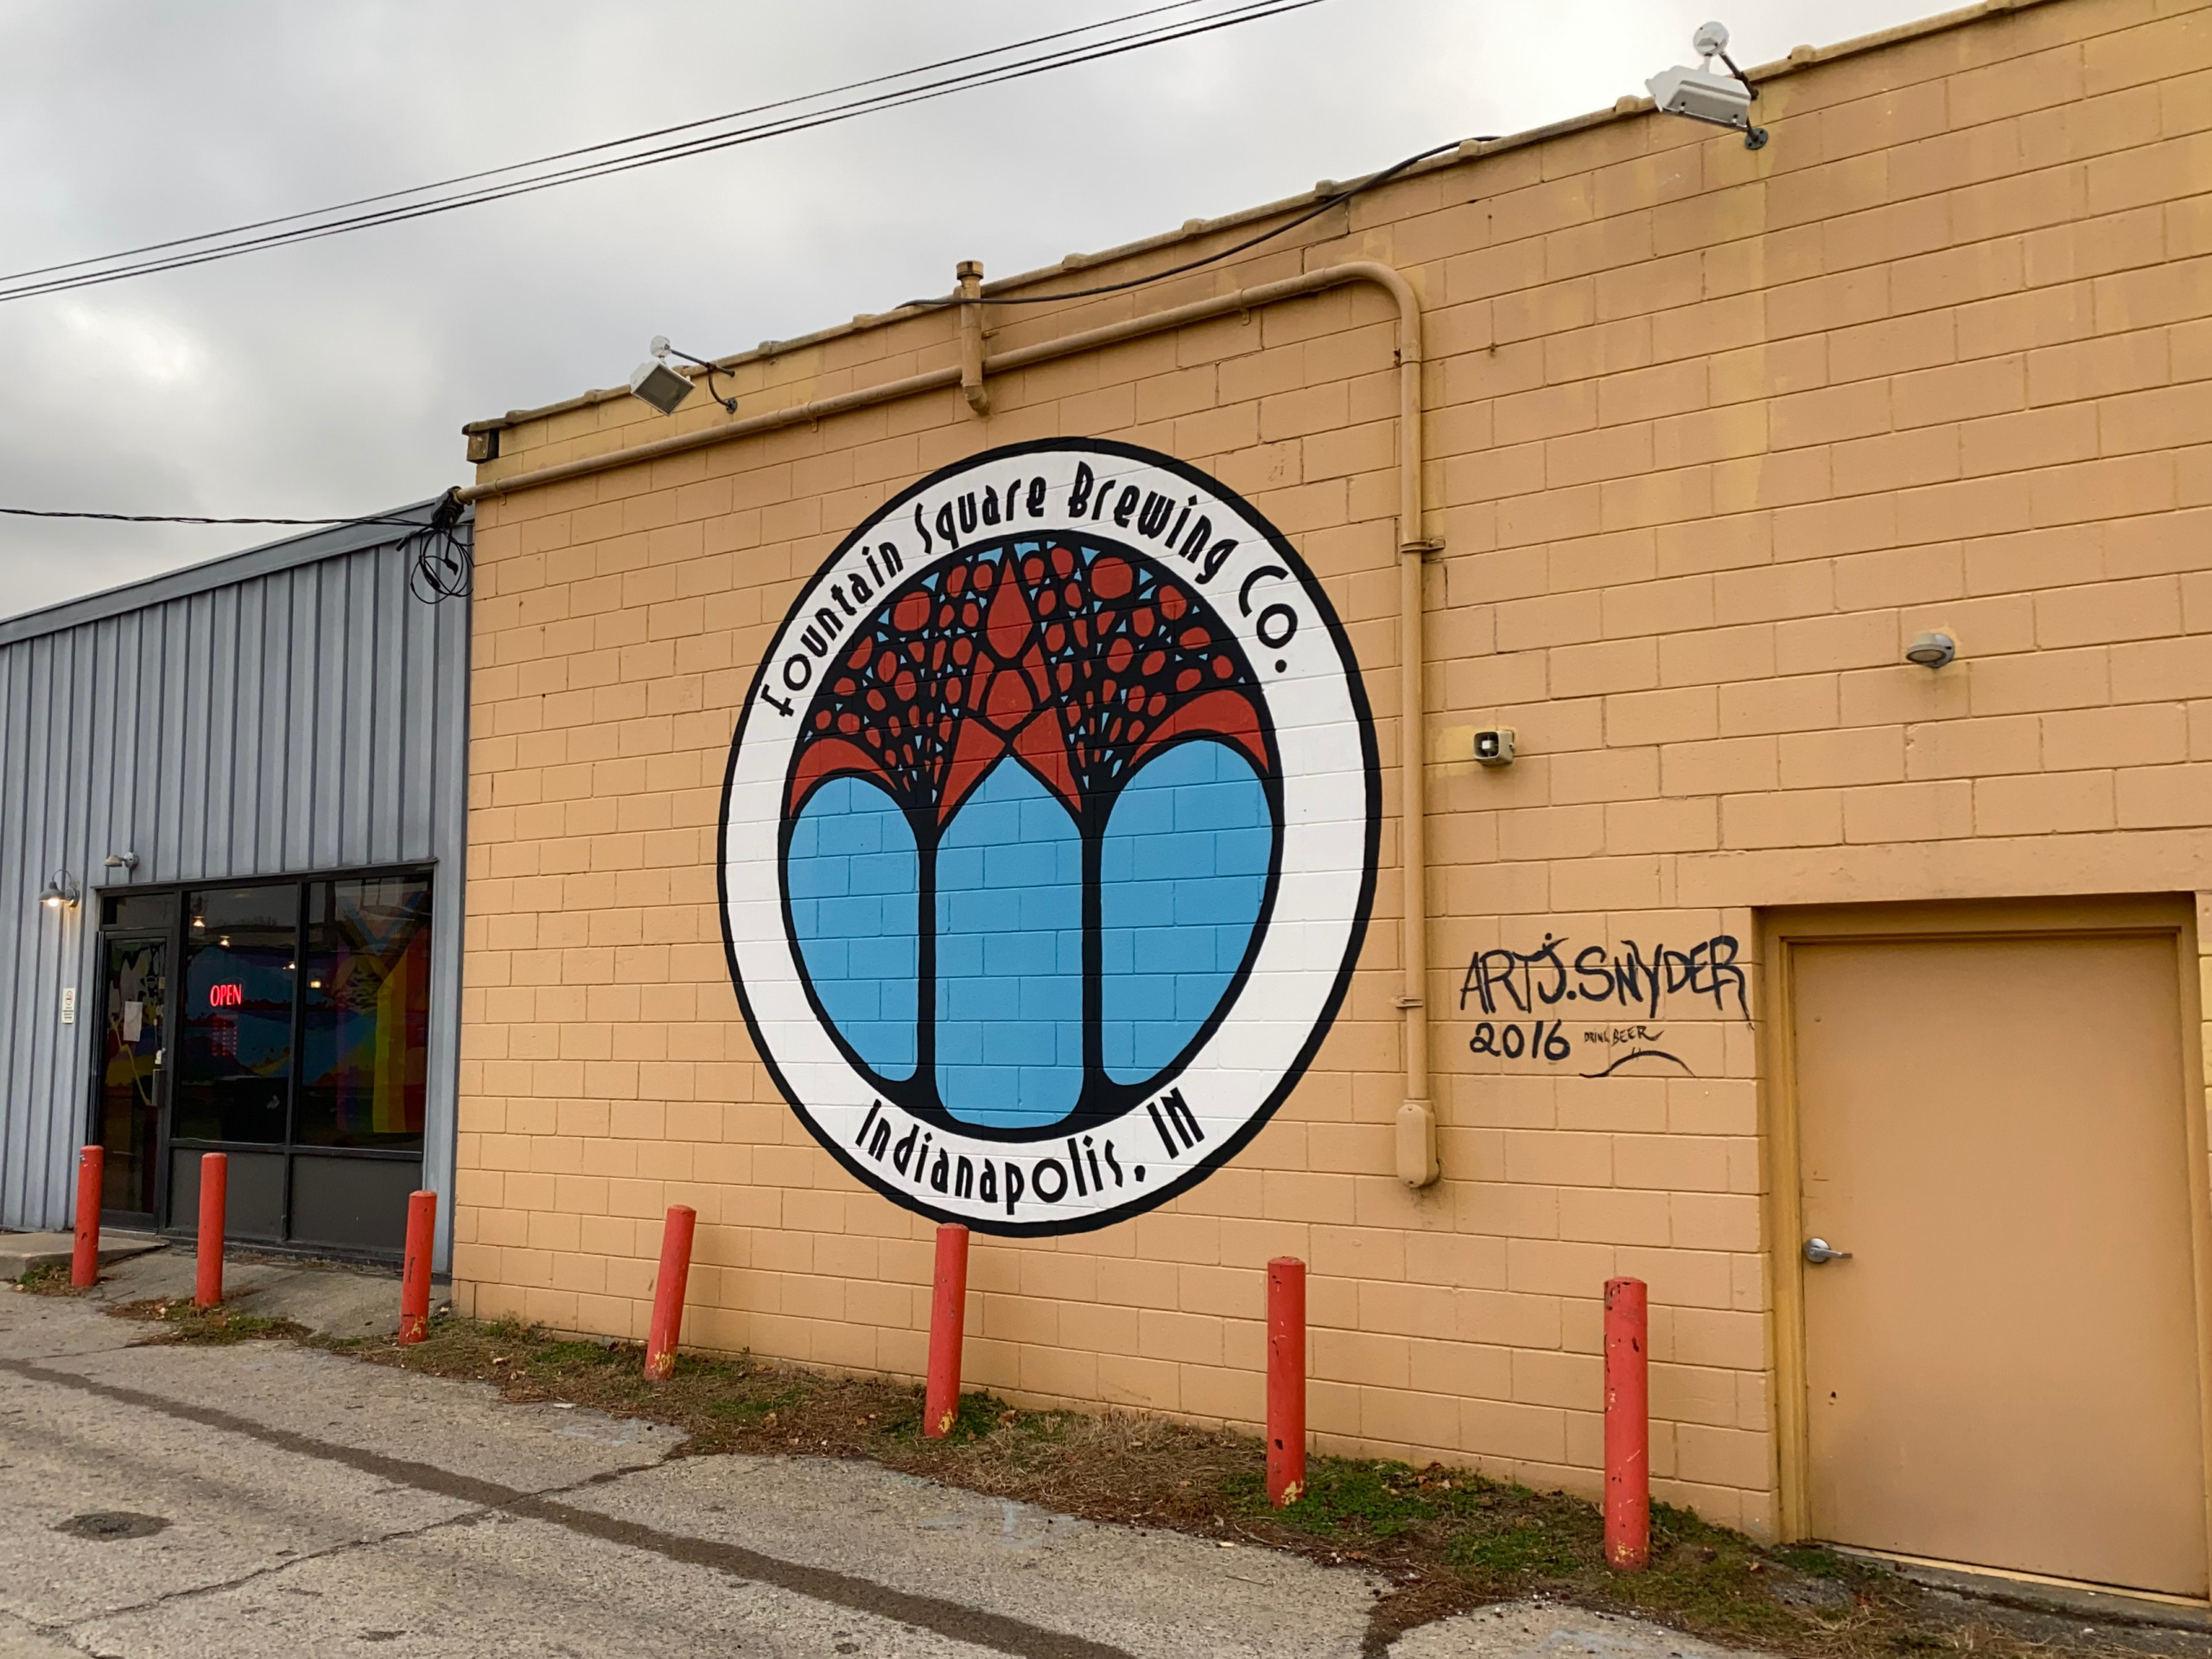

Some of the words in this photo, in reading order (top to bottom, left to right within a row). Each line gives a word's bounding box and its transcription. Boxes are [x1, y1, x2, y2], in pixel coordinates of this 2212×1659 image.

[760, 543, 905, 718] Fountain
[913, 475, 1047, 555] Square
[1068, 460, 1239, 585] Brewing
[1238, 564, 1299, 674] Co.
[209, 983, 242, 1007] OPEN
[1470, 1019, 1571, 1062] 2016
[1611, 1025, 1665, 1047] BEER
[1146, 1086, 1206, 1160] IN
